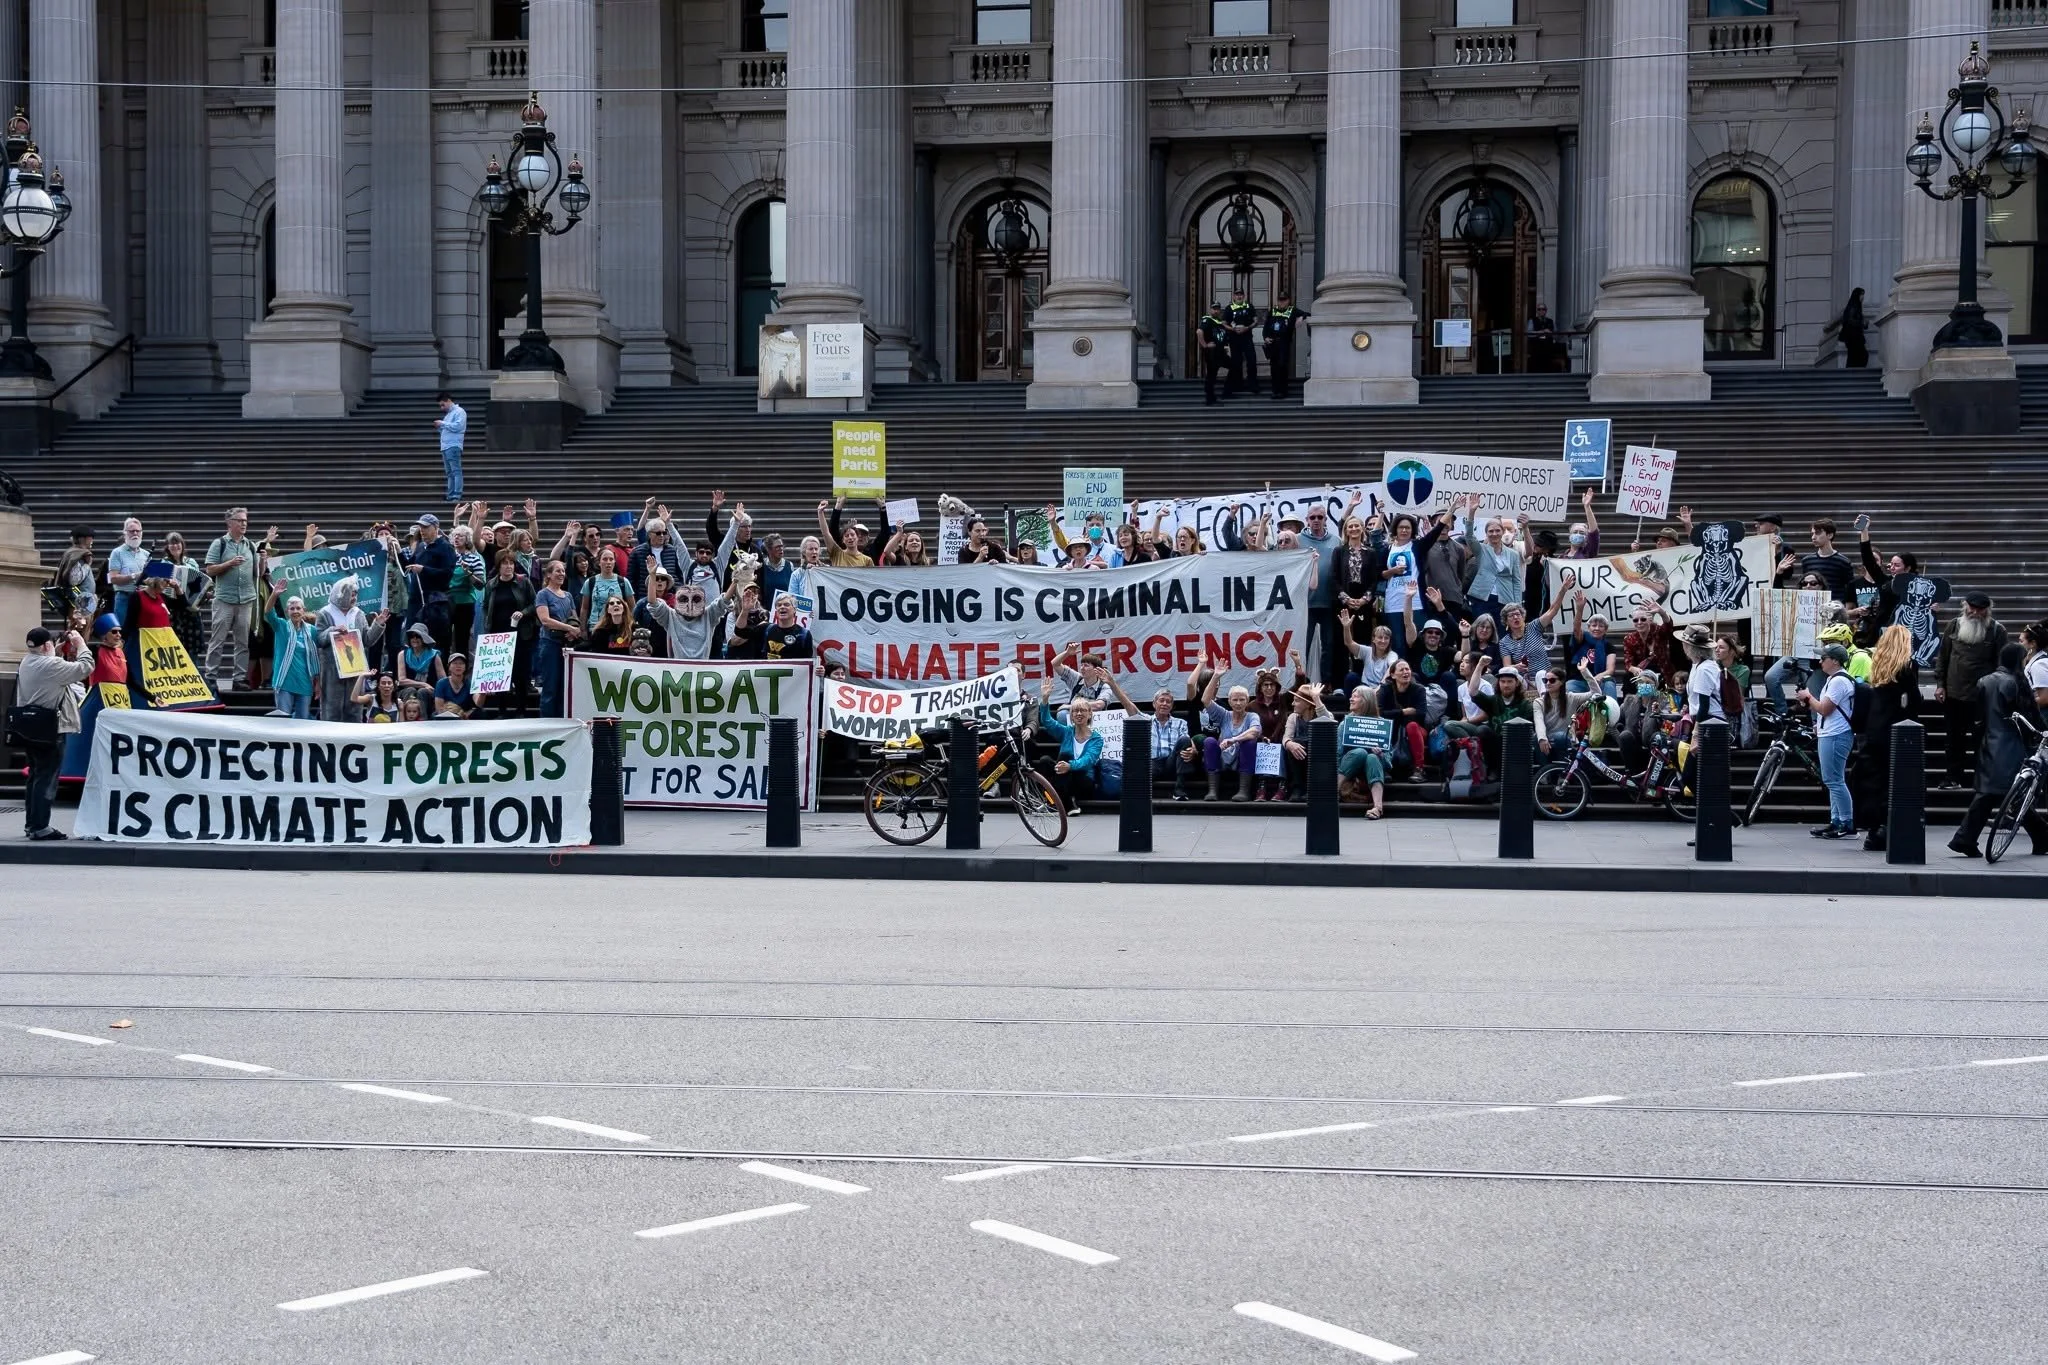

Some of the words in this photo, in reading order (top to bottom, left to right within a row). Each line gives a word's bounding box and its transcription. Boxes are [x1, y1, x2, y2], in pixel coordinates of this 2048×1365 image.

[813, 331, 842, 343] Free
[813, 343, 850, 355] Tours
[836, 429, 881, 443] People
[843, 445, 875, 456] need
[840, 459, 878, 471] Parks
[1632, 452, 1647, 467] It's
[1651, 454, 1675, 472] Time!
[1065, 471, 1085, 479] FORESTS
[1443, 463, 1500, 483] RUBICON
[1503, 467, 1555, 485] FOREST
[1638, 469, 1659, 481] End
[1086, 482, 1107, 494] END
[1623, 480, 1662, 500] Logging
[1067, 497, 1093, 507] NATIVE
[1096, 497, 1122, 507] FOREST
[1519, 495, 1564, 513] GROUP
[1629, 498, 1665, 515] NOW!
[285, 560, 338, 581] Climate
[340, 552, 375, 571] Choir
[1559, 564, 1616, 590] OUR
[817, 585, 982, 623] LOGGING
[994, 587, 1025, 622] IS
[1035, 577, 1211, 623] CRIMINAL
[1222, 575, 1255, 612] IN
[1265, 574, 1294, 610] A
[483, 634, 510, 644] STOP
[144, 646, 187, 671] SAVE
[479, 645, 509, 656] Native
[480, 657, 505, 669] Forest
[816, 639, 1000, 681] CLIMATE
[476, 670, 505, 681] Logging
[480, 675, 510, 691] NOW!
[588, 667, 794, 716] WOMBAT
[837, 685, 902, 715] STOP
[911, 674, 1008, 713] TRASHING
[829, 708, 924, 739] WOMBAT
[1107, 712, 1123, 721] OUR
[621, 719, 766, 759] FOREST
[110, 733, 368, 784] PROTECTING
[383, 739, 567, 785] FORESTS
[651, 764, 702, 794] FOR
[713, 764, 769, 800] SAL
[107, 789, 152, 838] IS
[164, 793, 368, 843] CLIMATE
[379, 795, 564, 845] ACTION
